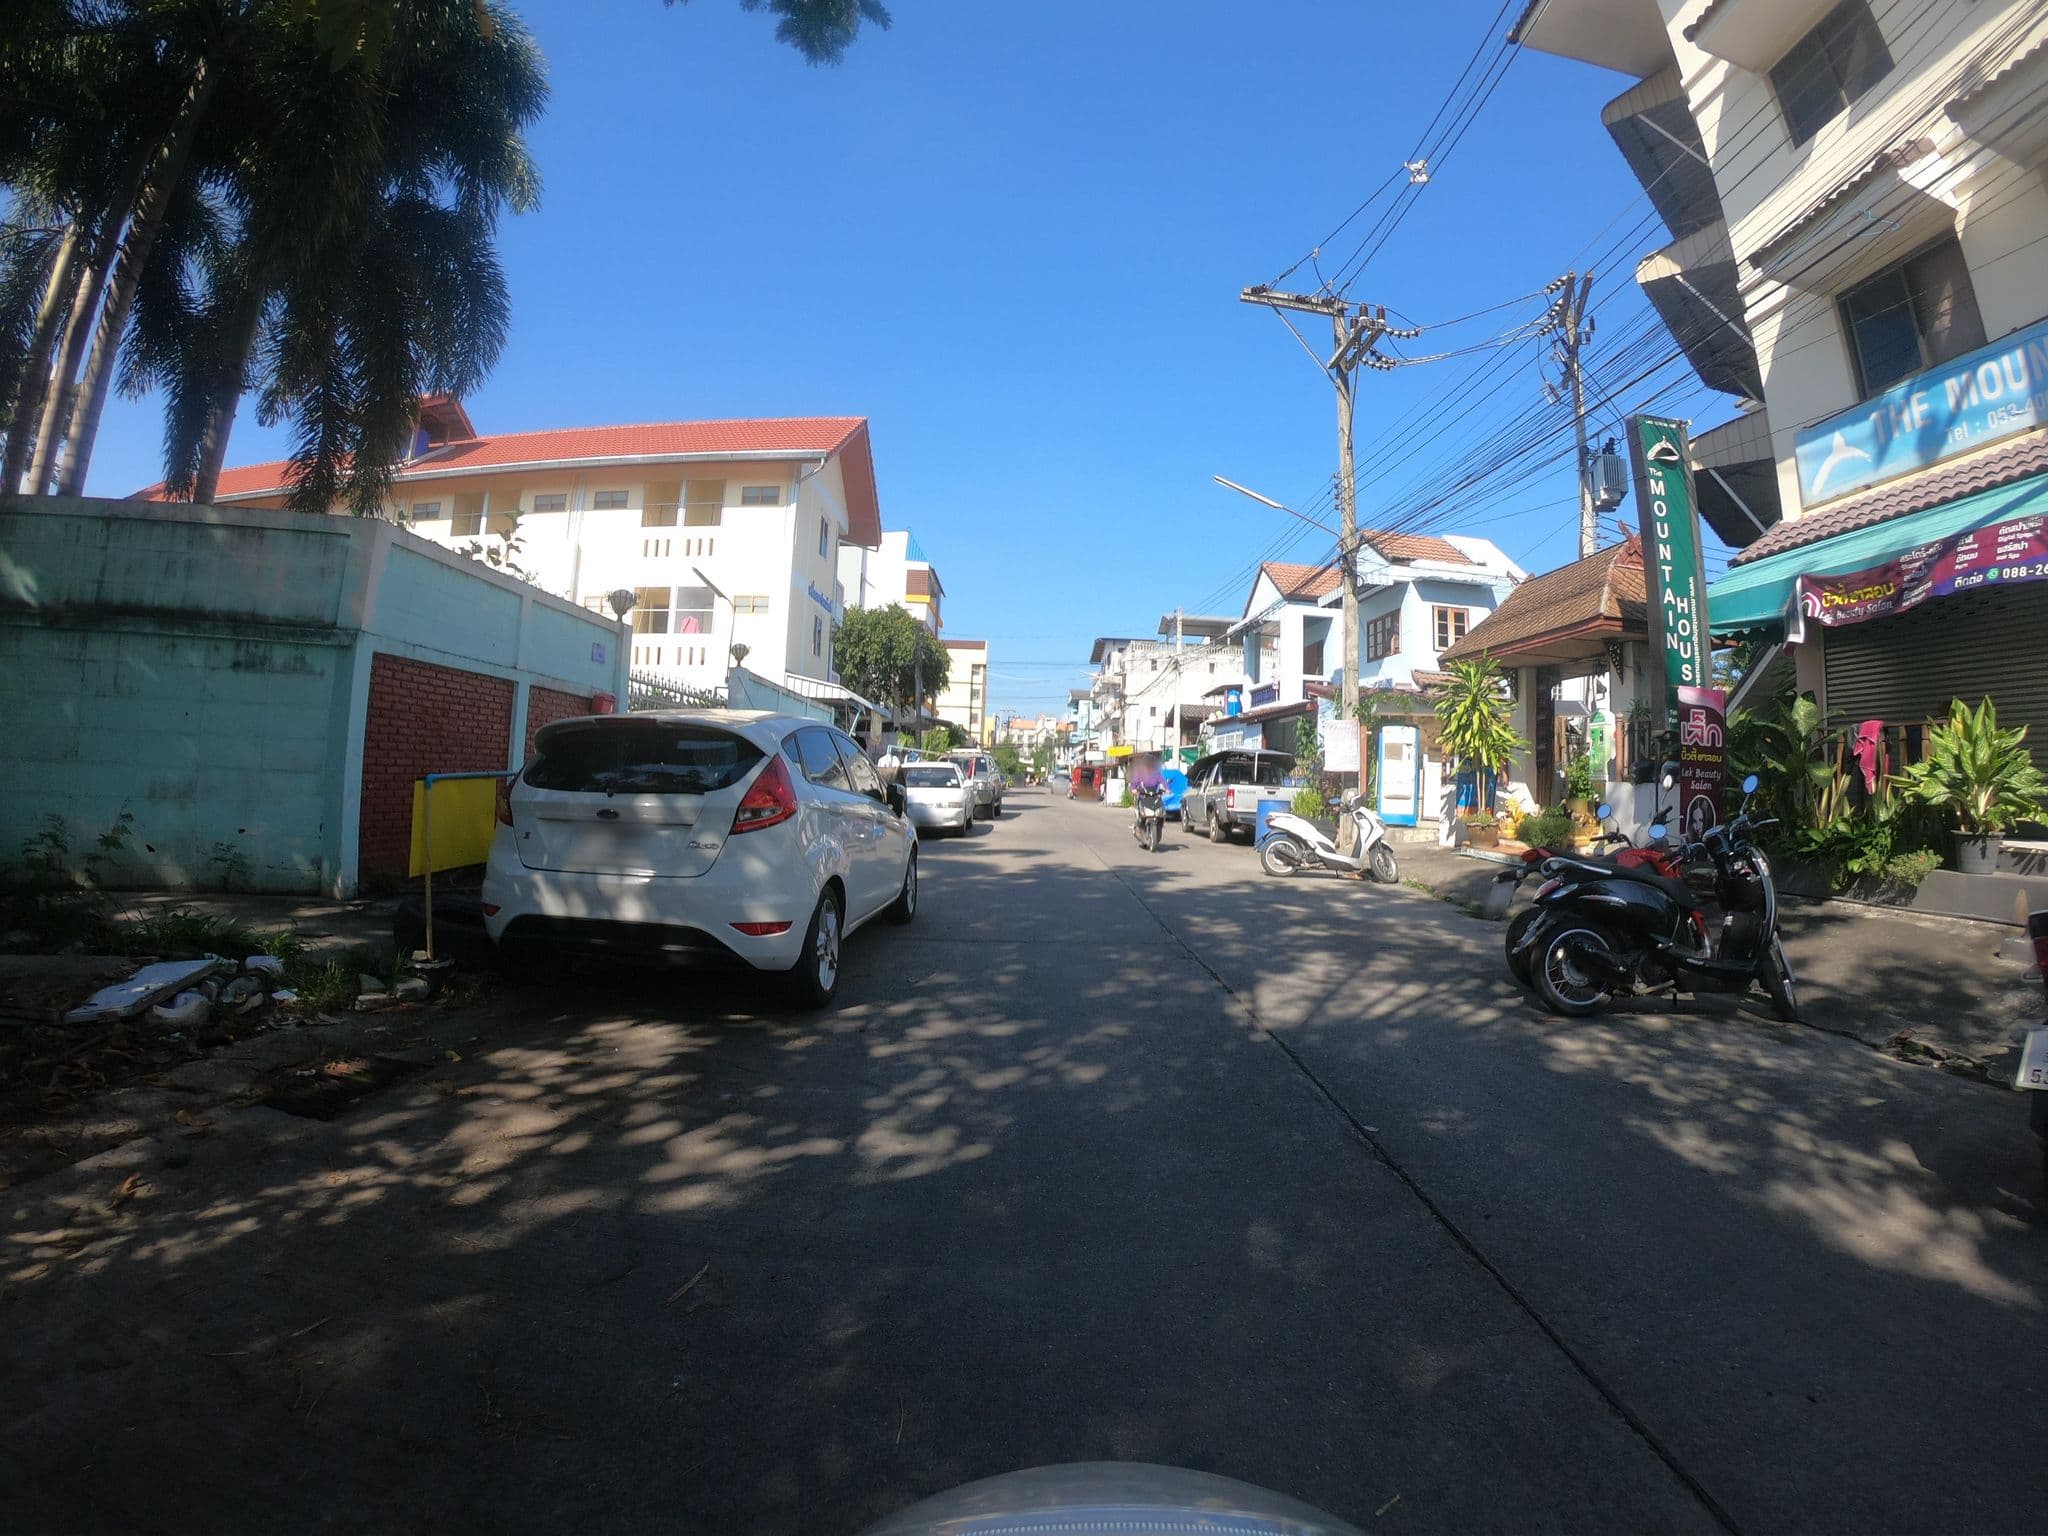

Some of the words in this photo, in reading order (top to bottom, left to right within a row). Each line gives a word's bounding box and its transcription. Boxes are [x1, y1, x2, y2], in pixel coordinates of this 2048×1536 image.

[1870, 391, 1932, 444] THE
[1944, 421, 1968, 444] Tel
[1650, 478, 1678, 650] MOUNTAIN
[1866, 600, 1893, 614] Salon
[1680, 708, 1723, 748] เล็ก
[1681, 768, 1694, 778] Lek
[1695, 768, 1722, 780] Beauty
[1690, 779, 1713, 791] Salon
